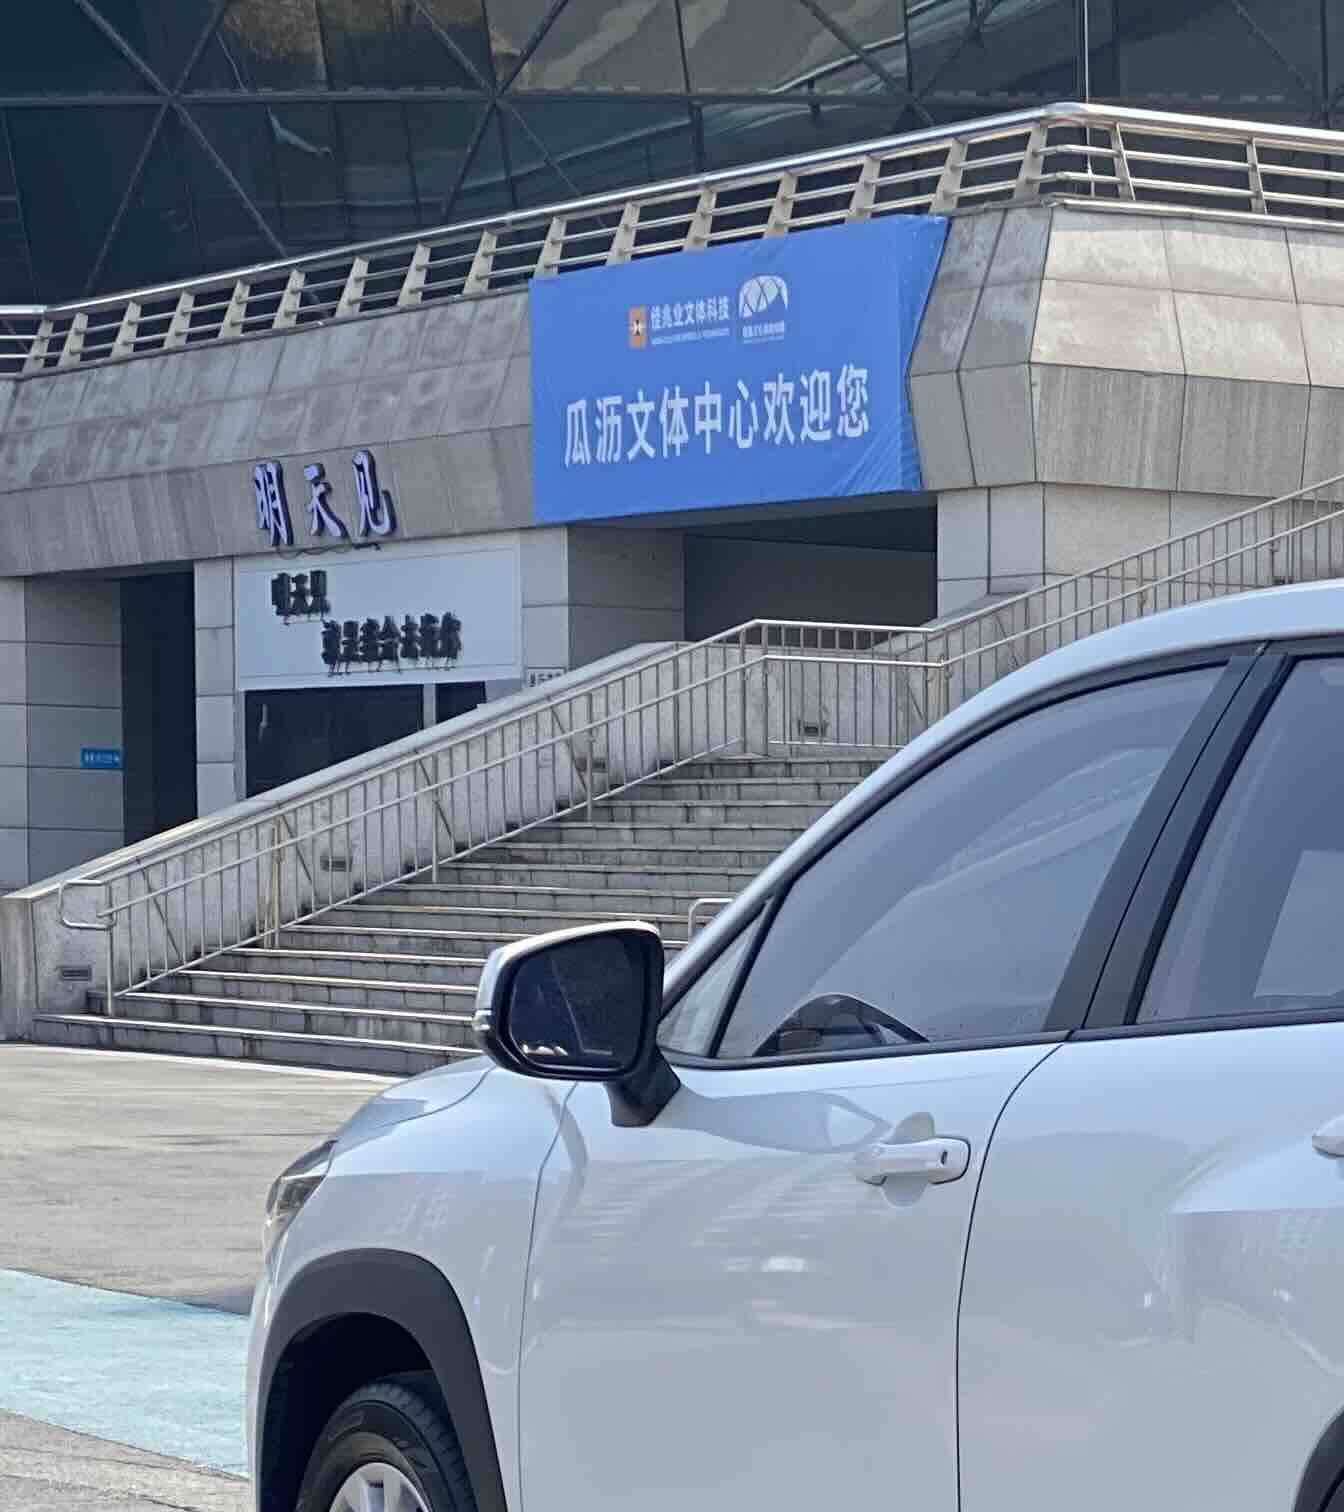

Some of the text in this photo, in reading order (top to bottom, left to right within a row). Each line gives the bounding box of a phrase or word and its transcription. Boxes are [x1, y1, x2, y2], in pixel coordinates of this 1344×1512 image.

[564, 363, 870, 468] 瓜沥文体中心欢迎您
[254, 449, 398, 546] 明天见
